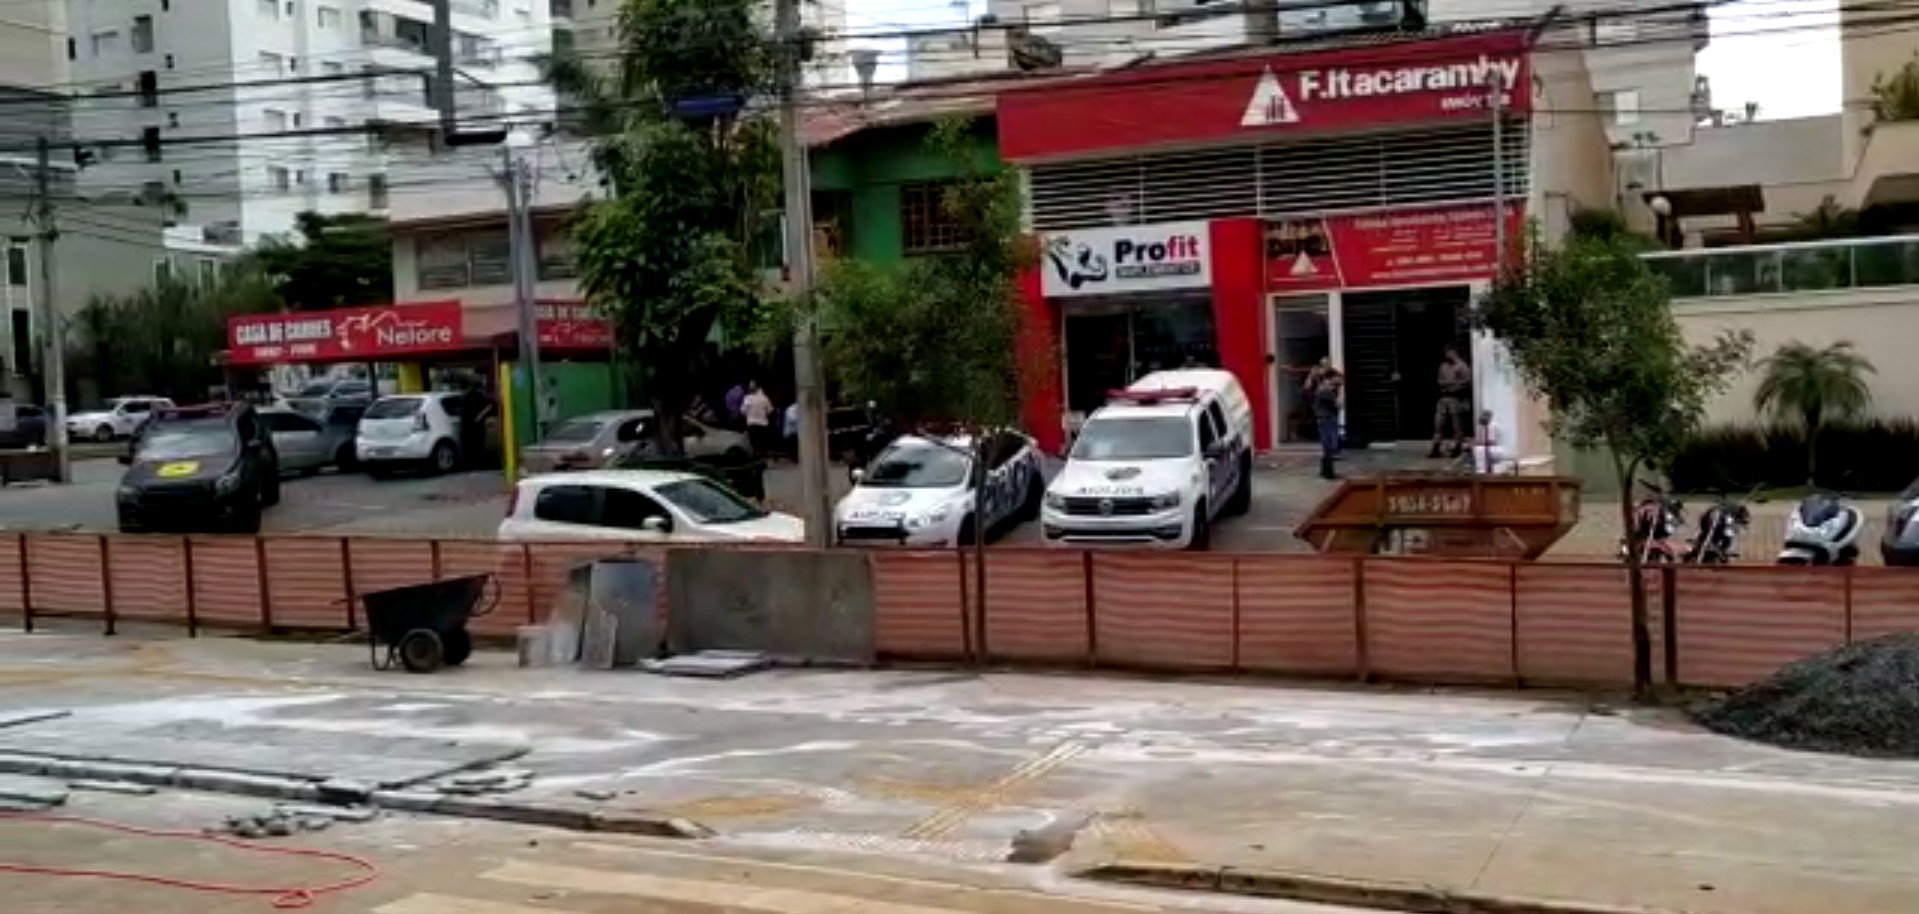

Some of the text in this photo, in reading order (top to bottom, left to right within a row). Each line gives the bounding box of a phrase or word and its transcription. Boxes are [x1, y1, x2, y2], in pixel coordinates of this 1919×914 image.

[1300, 55, 1519, 101] F.Itacaramby
[1115, 235, 1199, 264] Profit
[377, 325, 452, 345] Nelore
